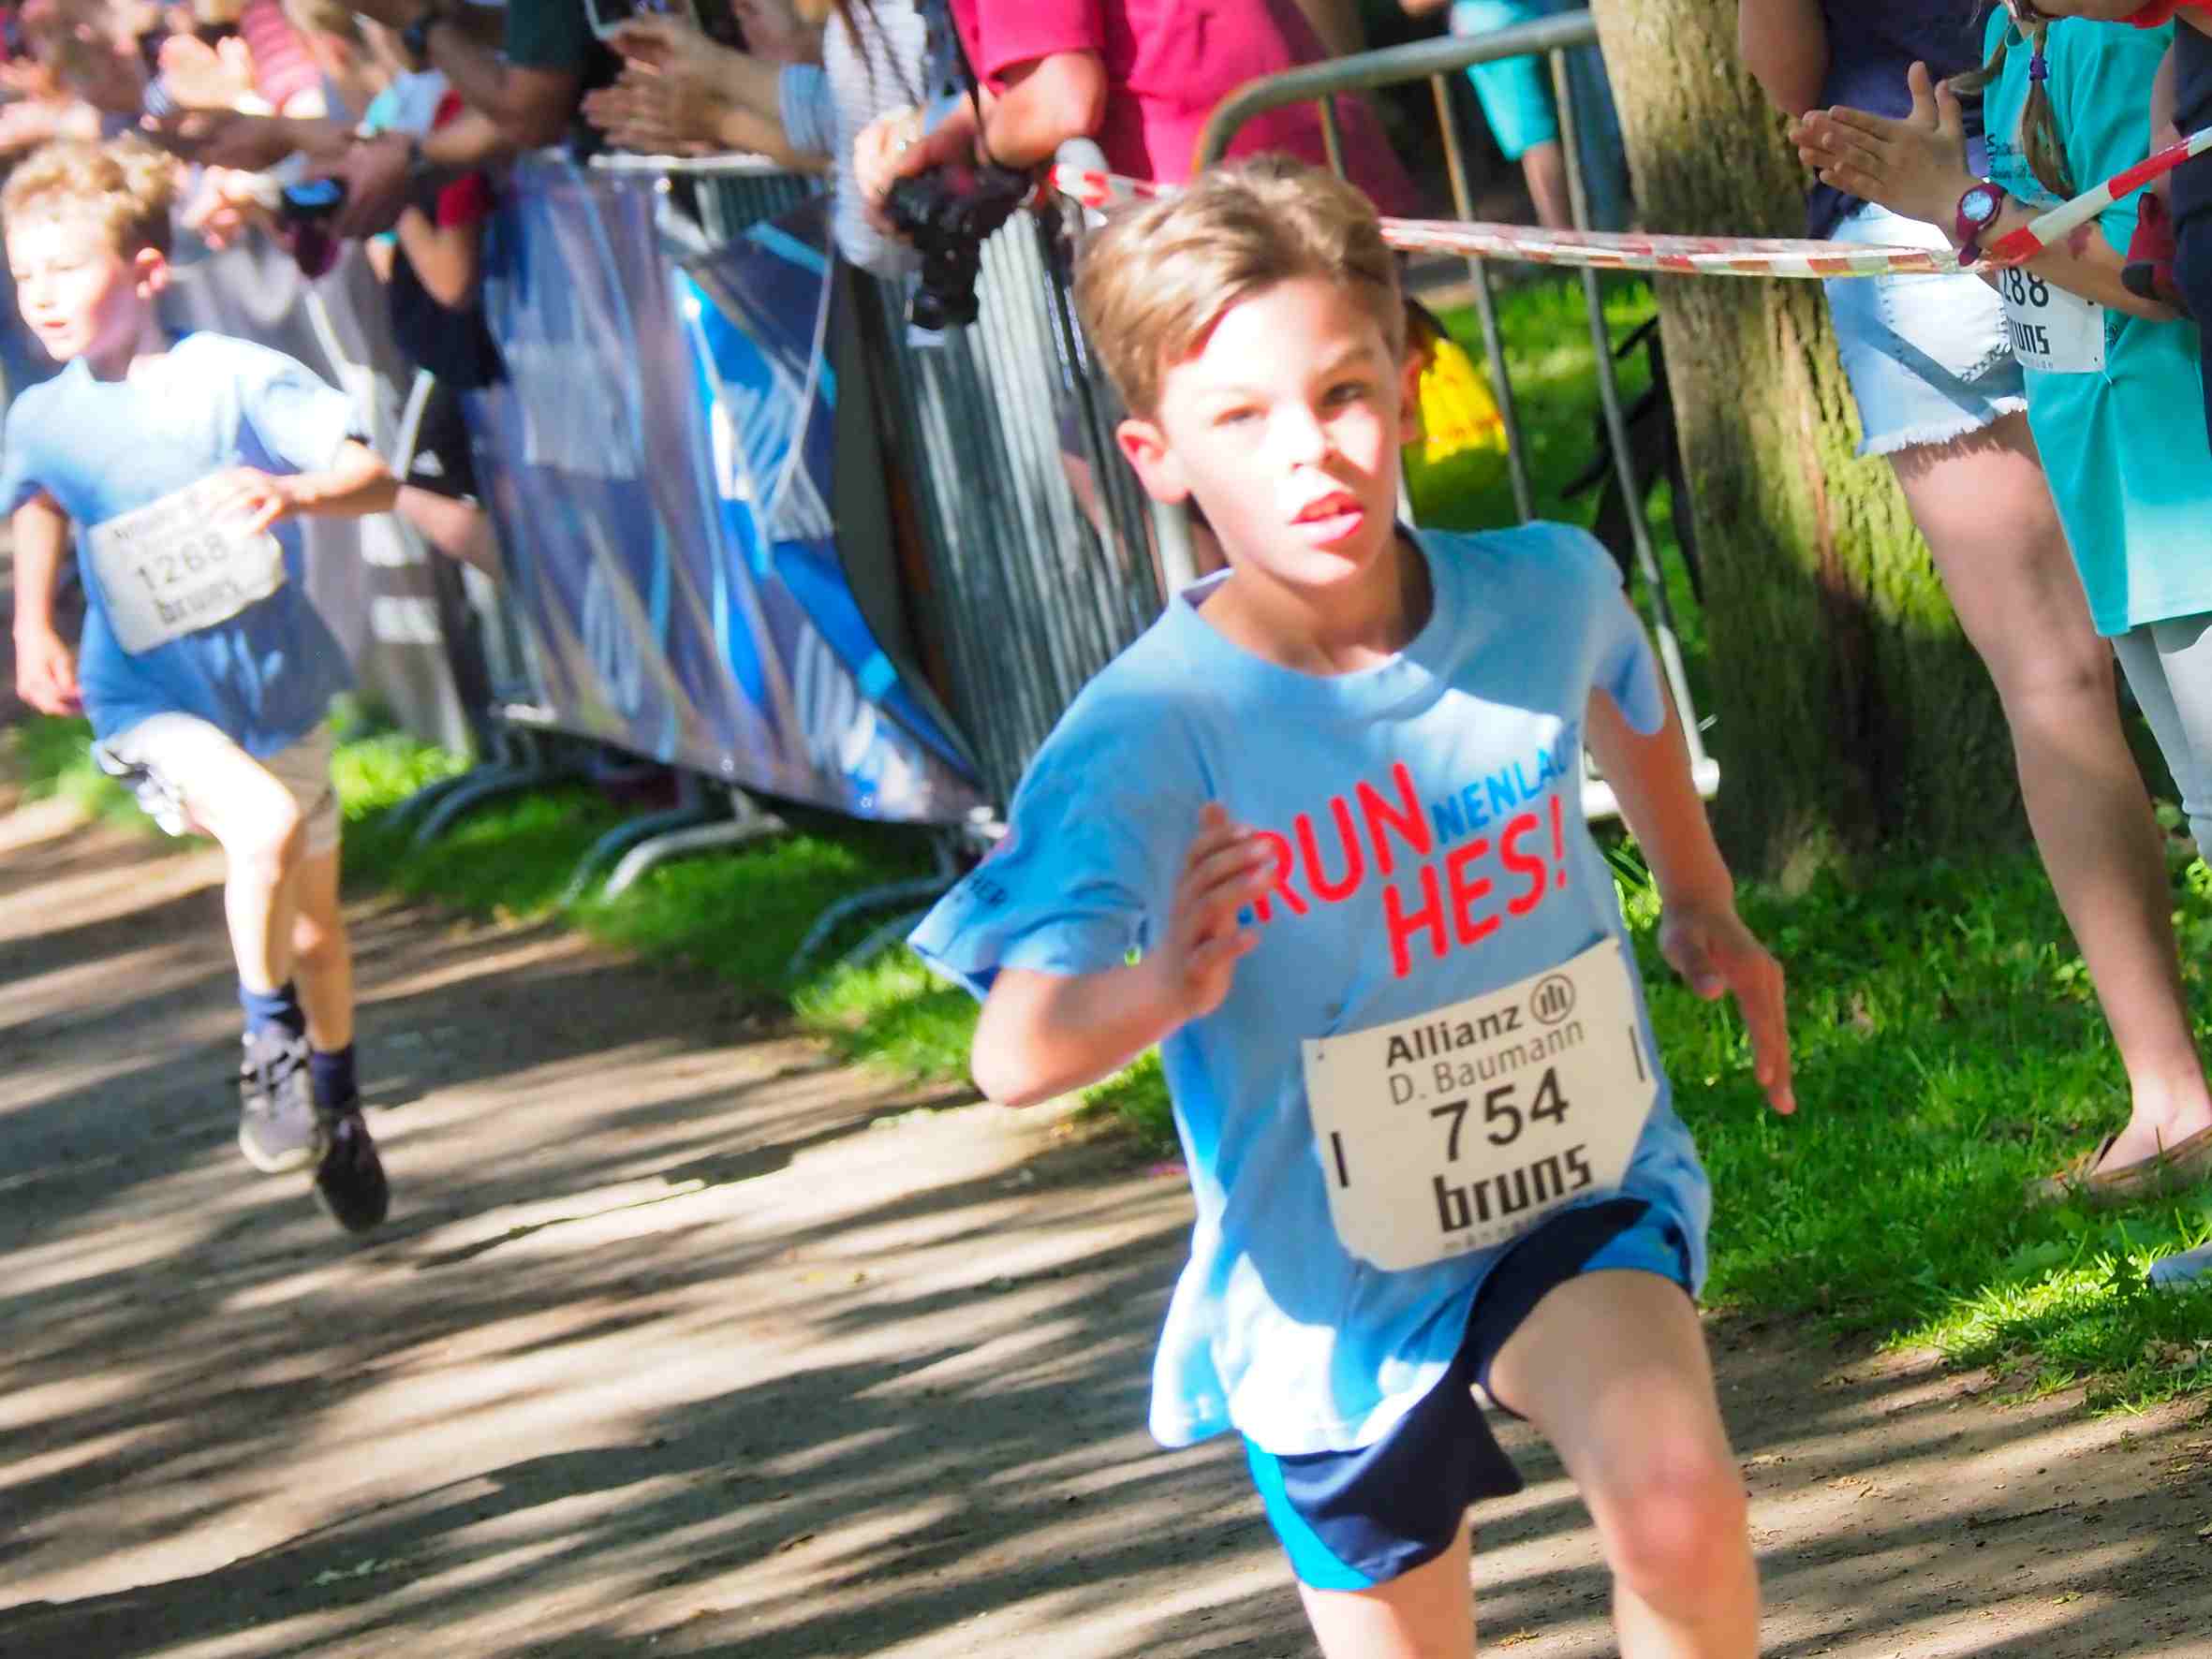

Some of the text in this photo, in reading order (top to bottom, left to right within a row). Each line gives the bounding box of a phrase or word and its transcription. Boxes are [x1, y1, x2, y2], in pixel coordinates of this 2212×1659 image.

[1382, 794, 1567, 978] HES!
[1386, 1005, 1525, 1069] Allianz
[1388, 1020, 1585, 1106] D. Baumann
[1429, 1066, 1570, 1164] 754
[1433, 1142, 1592, 1233] bruns
